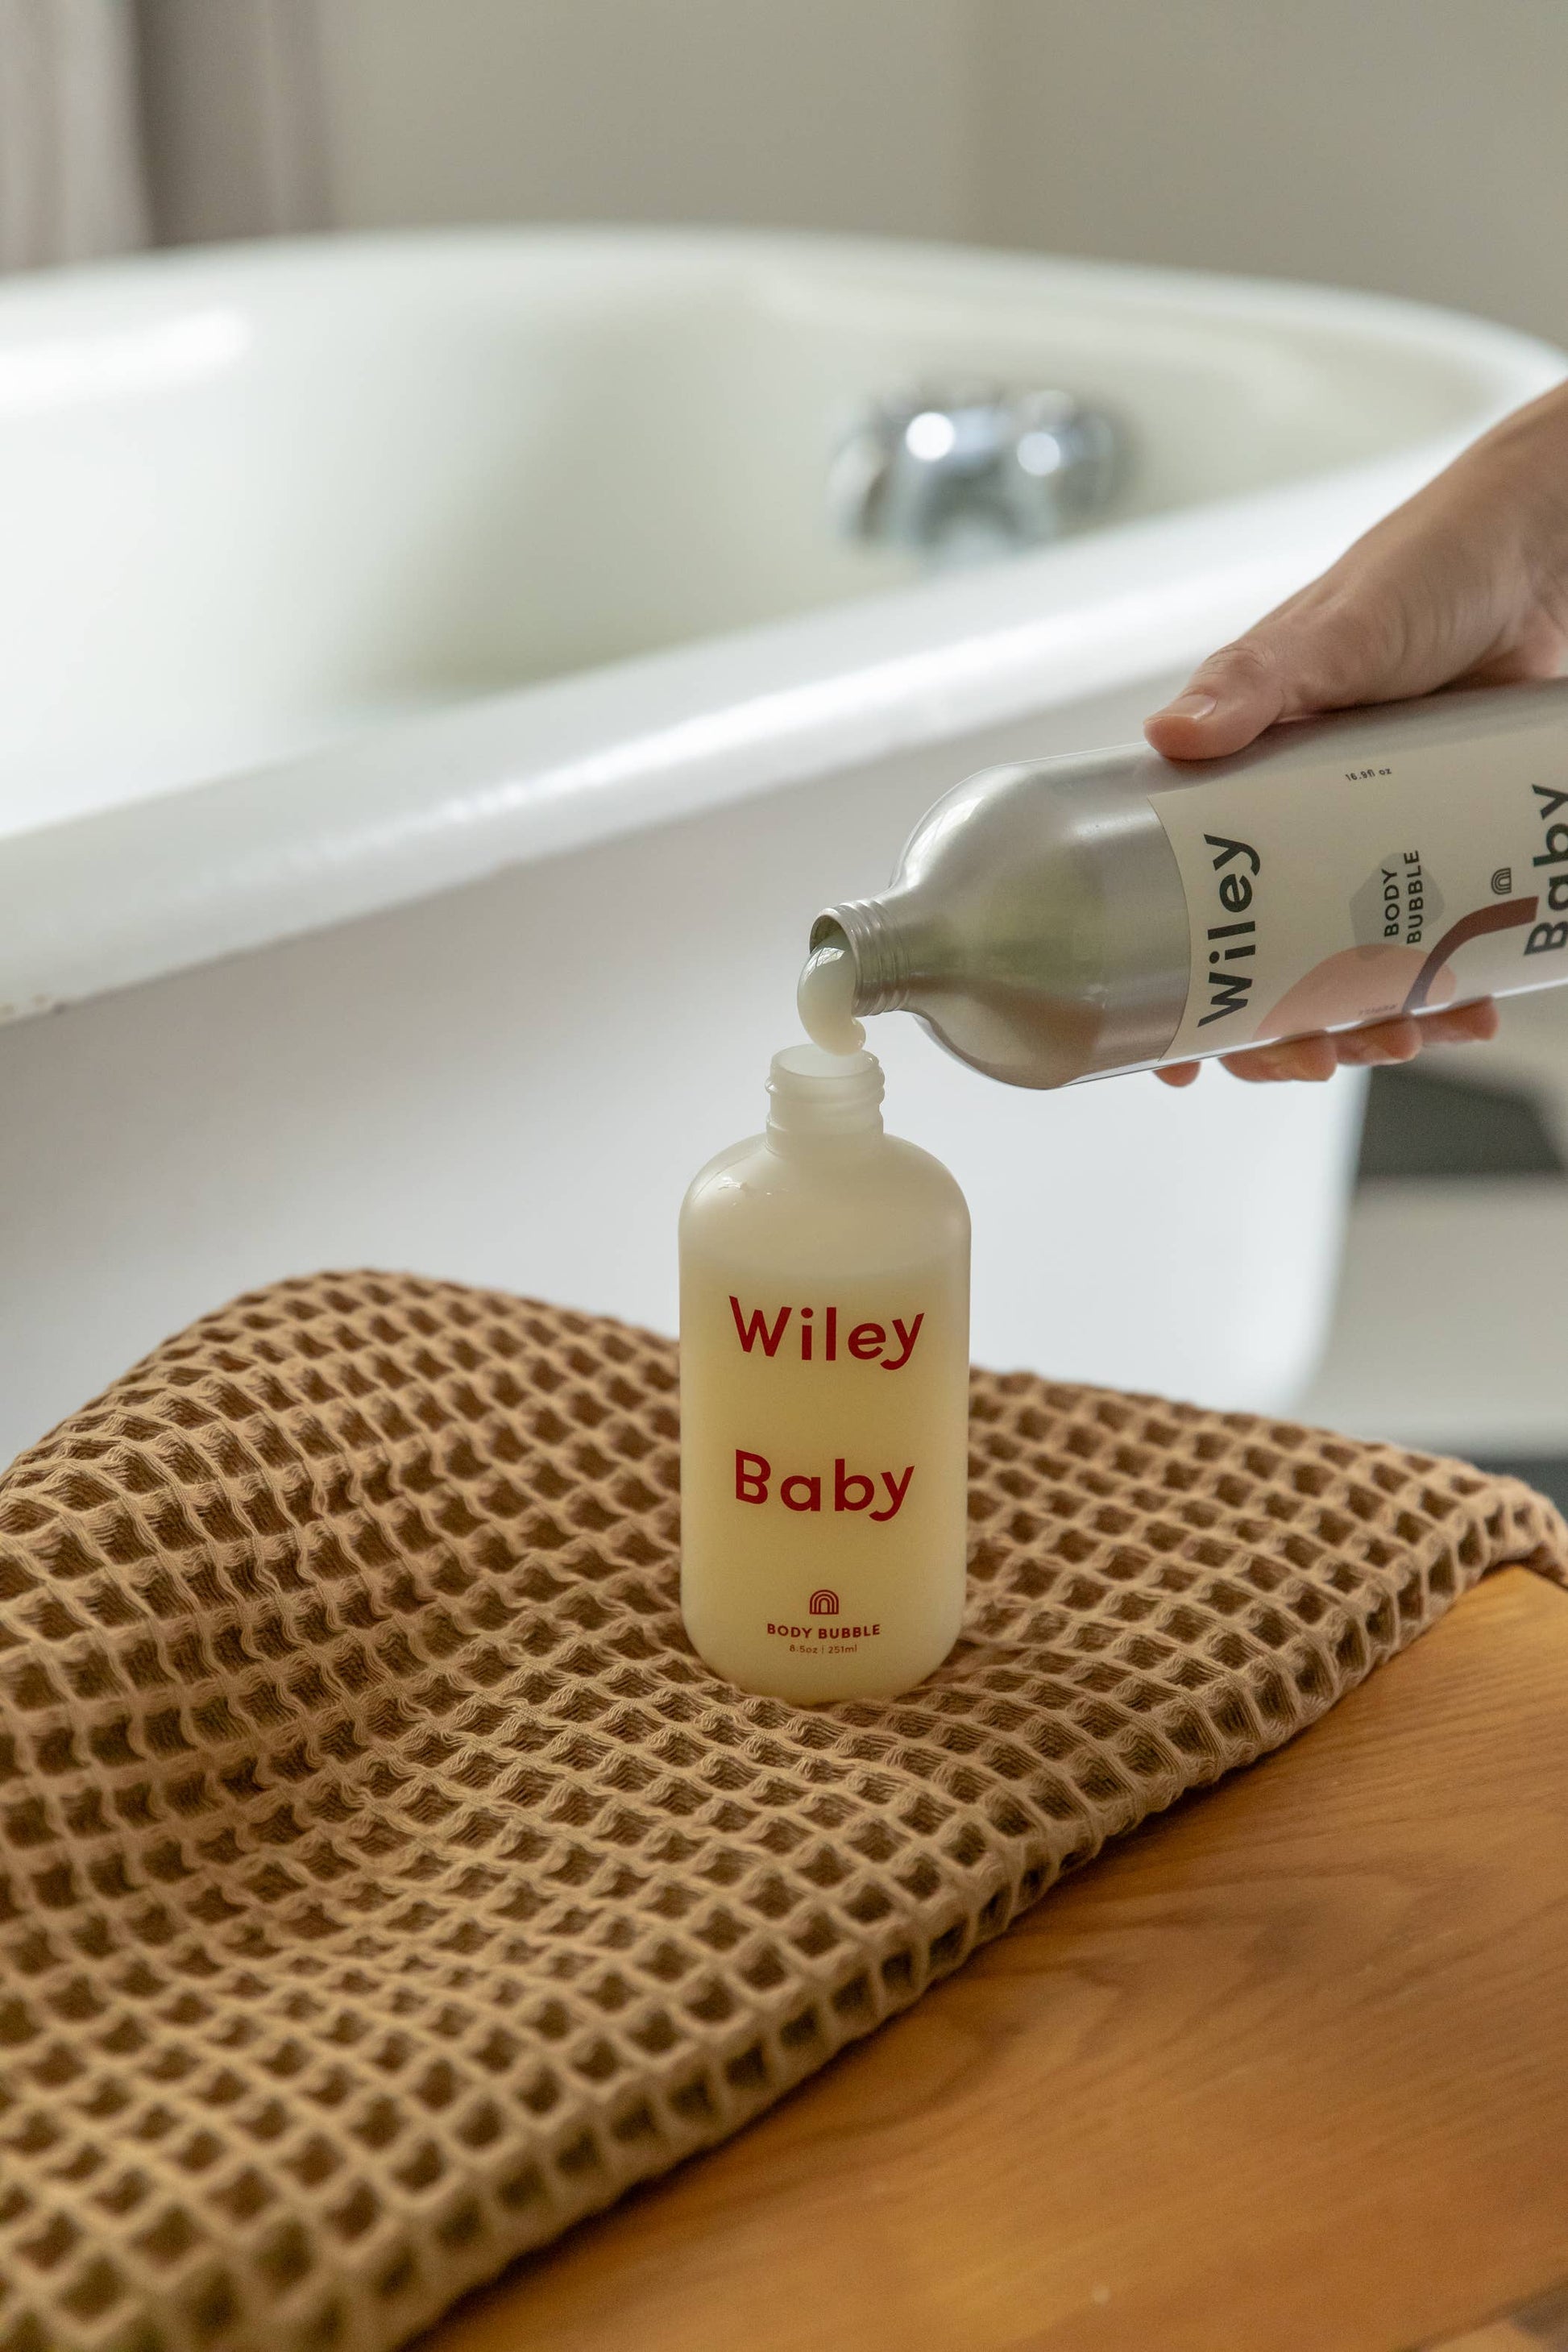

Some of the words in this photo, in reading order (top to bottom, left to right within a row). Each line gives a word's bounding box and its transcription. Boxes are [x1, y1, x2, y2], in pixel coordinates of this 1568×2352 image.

[1345, 769, 1375, 782] 16.9fl
[1381, 868, 1400, 937] BODY
[1404, 850, 1422, 944] BUBBLE
[1524, 784, 1568, 956] Baby
[1197, 833, 1261, 1028] Wiley
[728, 1295, 925, 1371] Wiley
[735, 1449, 915, 1522] Baby
[767, 1623, 812, 1639] BODY
[819, 1624, 880, 1639] BUBBLE
[789, 1644, 818, 1654] 8.5oz
[828, 1644, 857, 1654] 251ml
